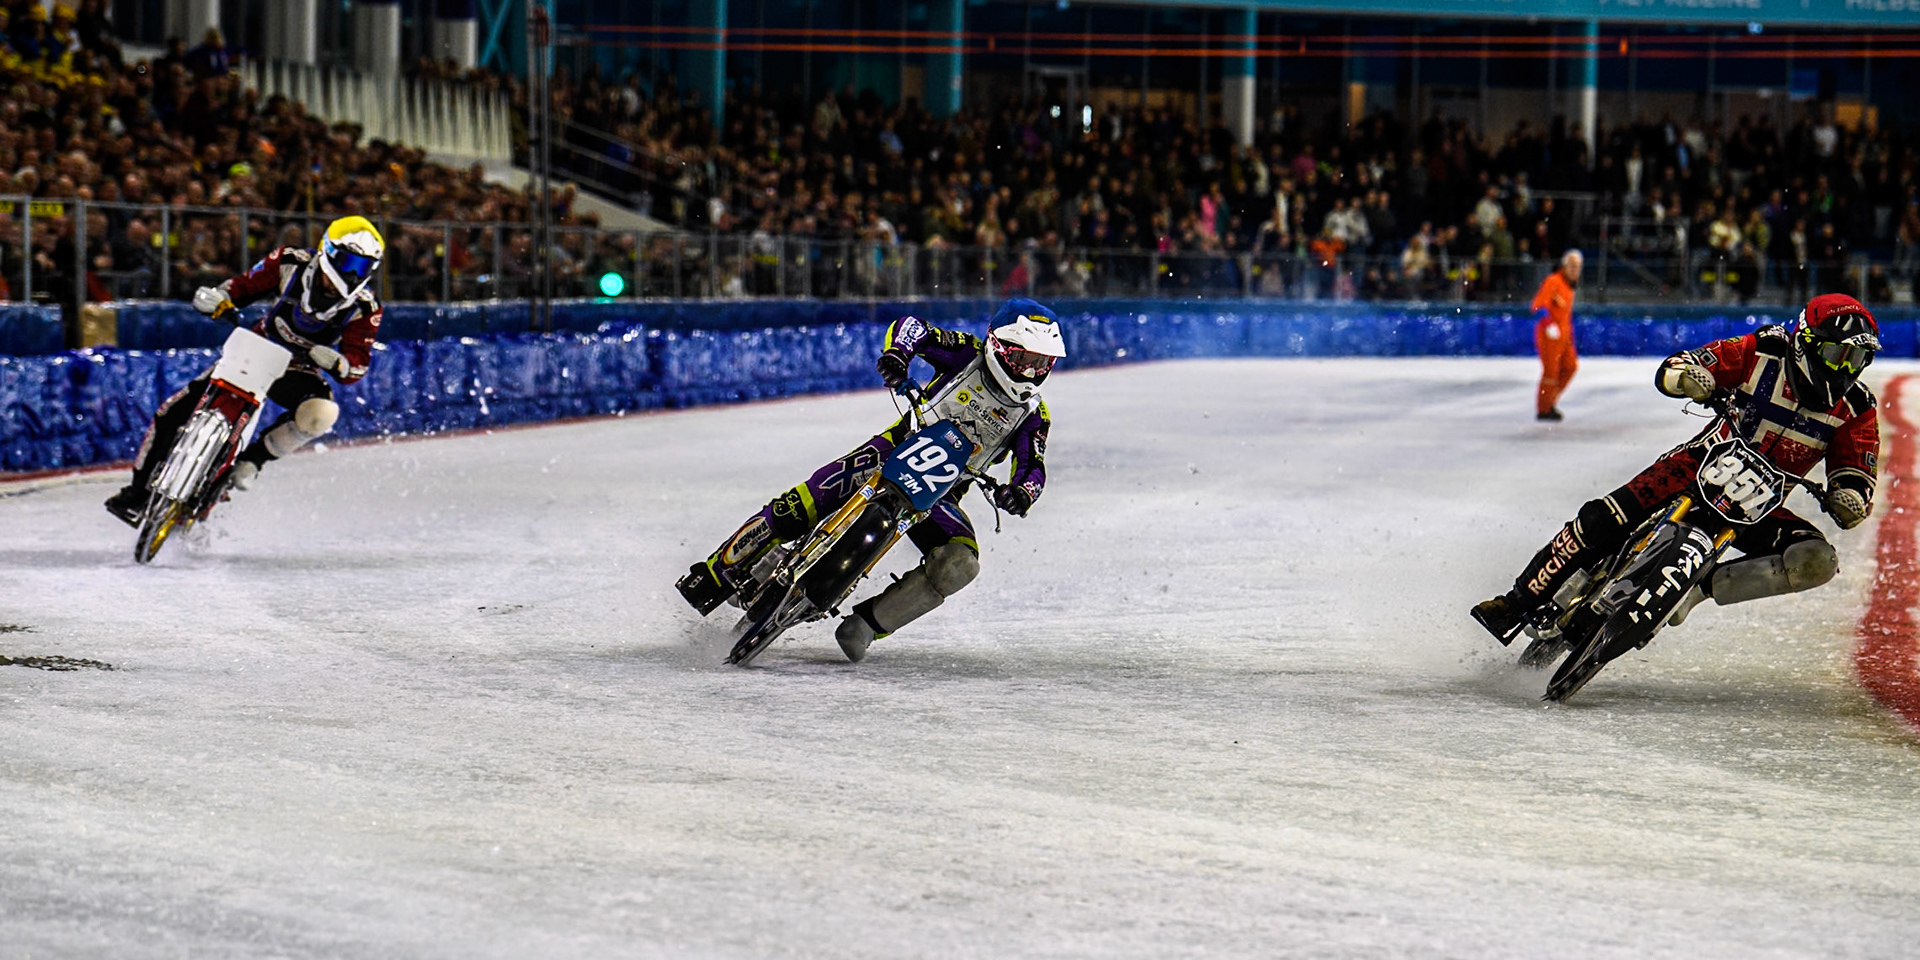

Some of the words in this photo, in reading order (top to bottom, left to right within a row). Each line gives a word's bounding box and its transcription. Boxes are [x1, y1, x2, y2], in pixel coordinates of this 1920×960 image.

[896, 436, 960, 493] 192
[898, 471, 923, 495] FIM
[1705, 456, 1775, 510] 357
[1528, 540, 1580, 596] RACING
